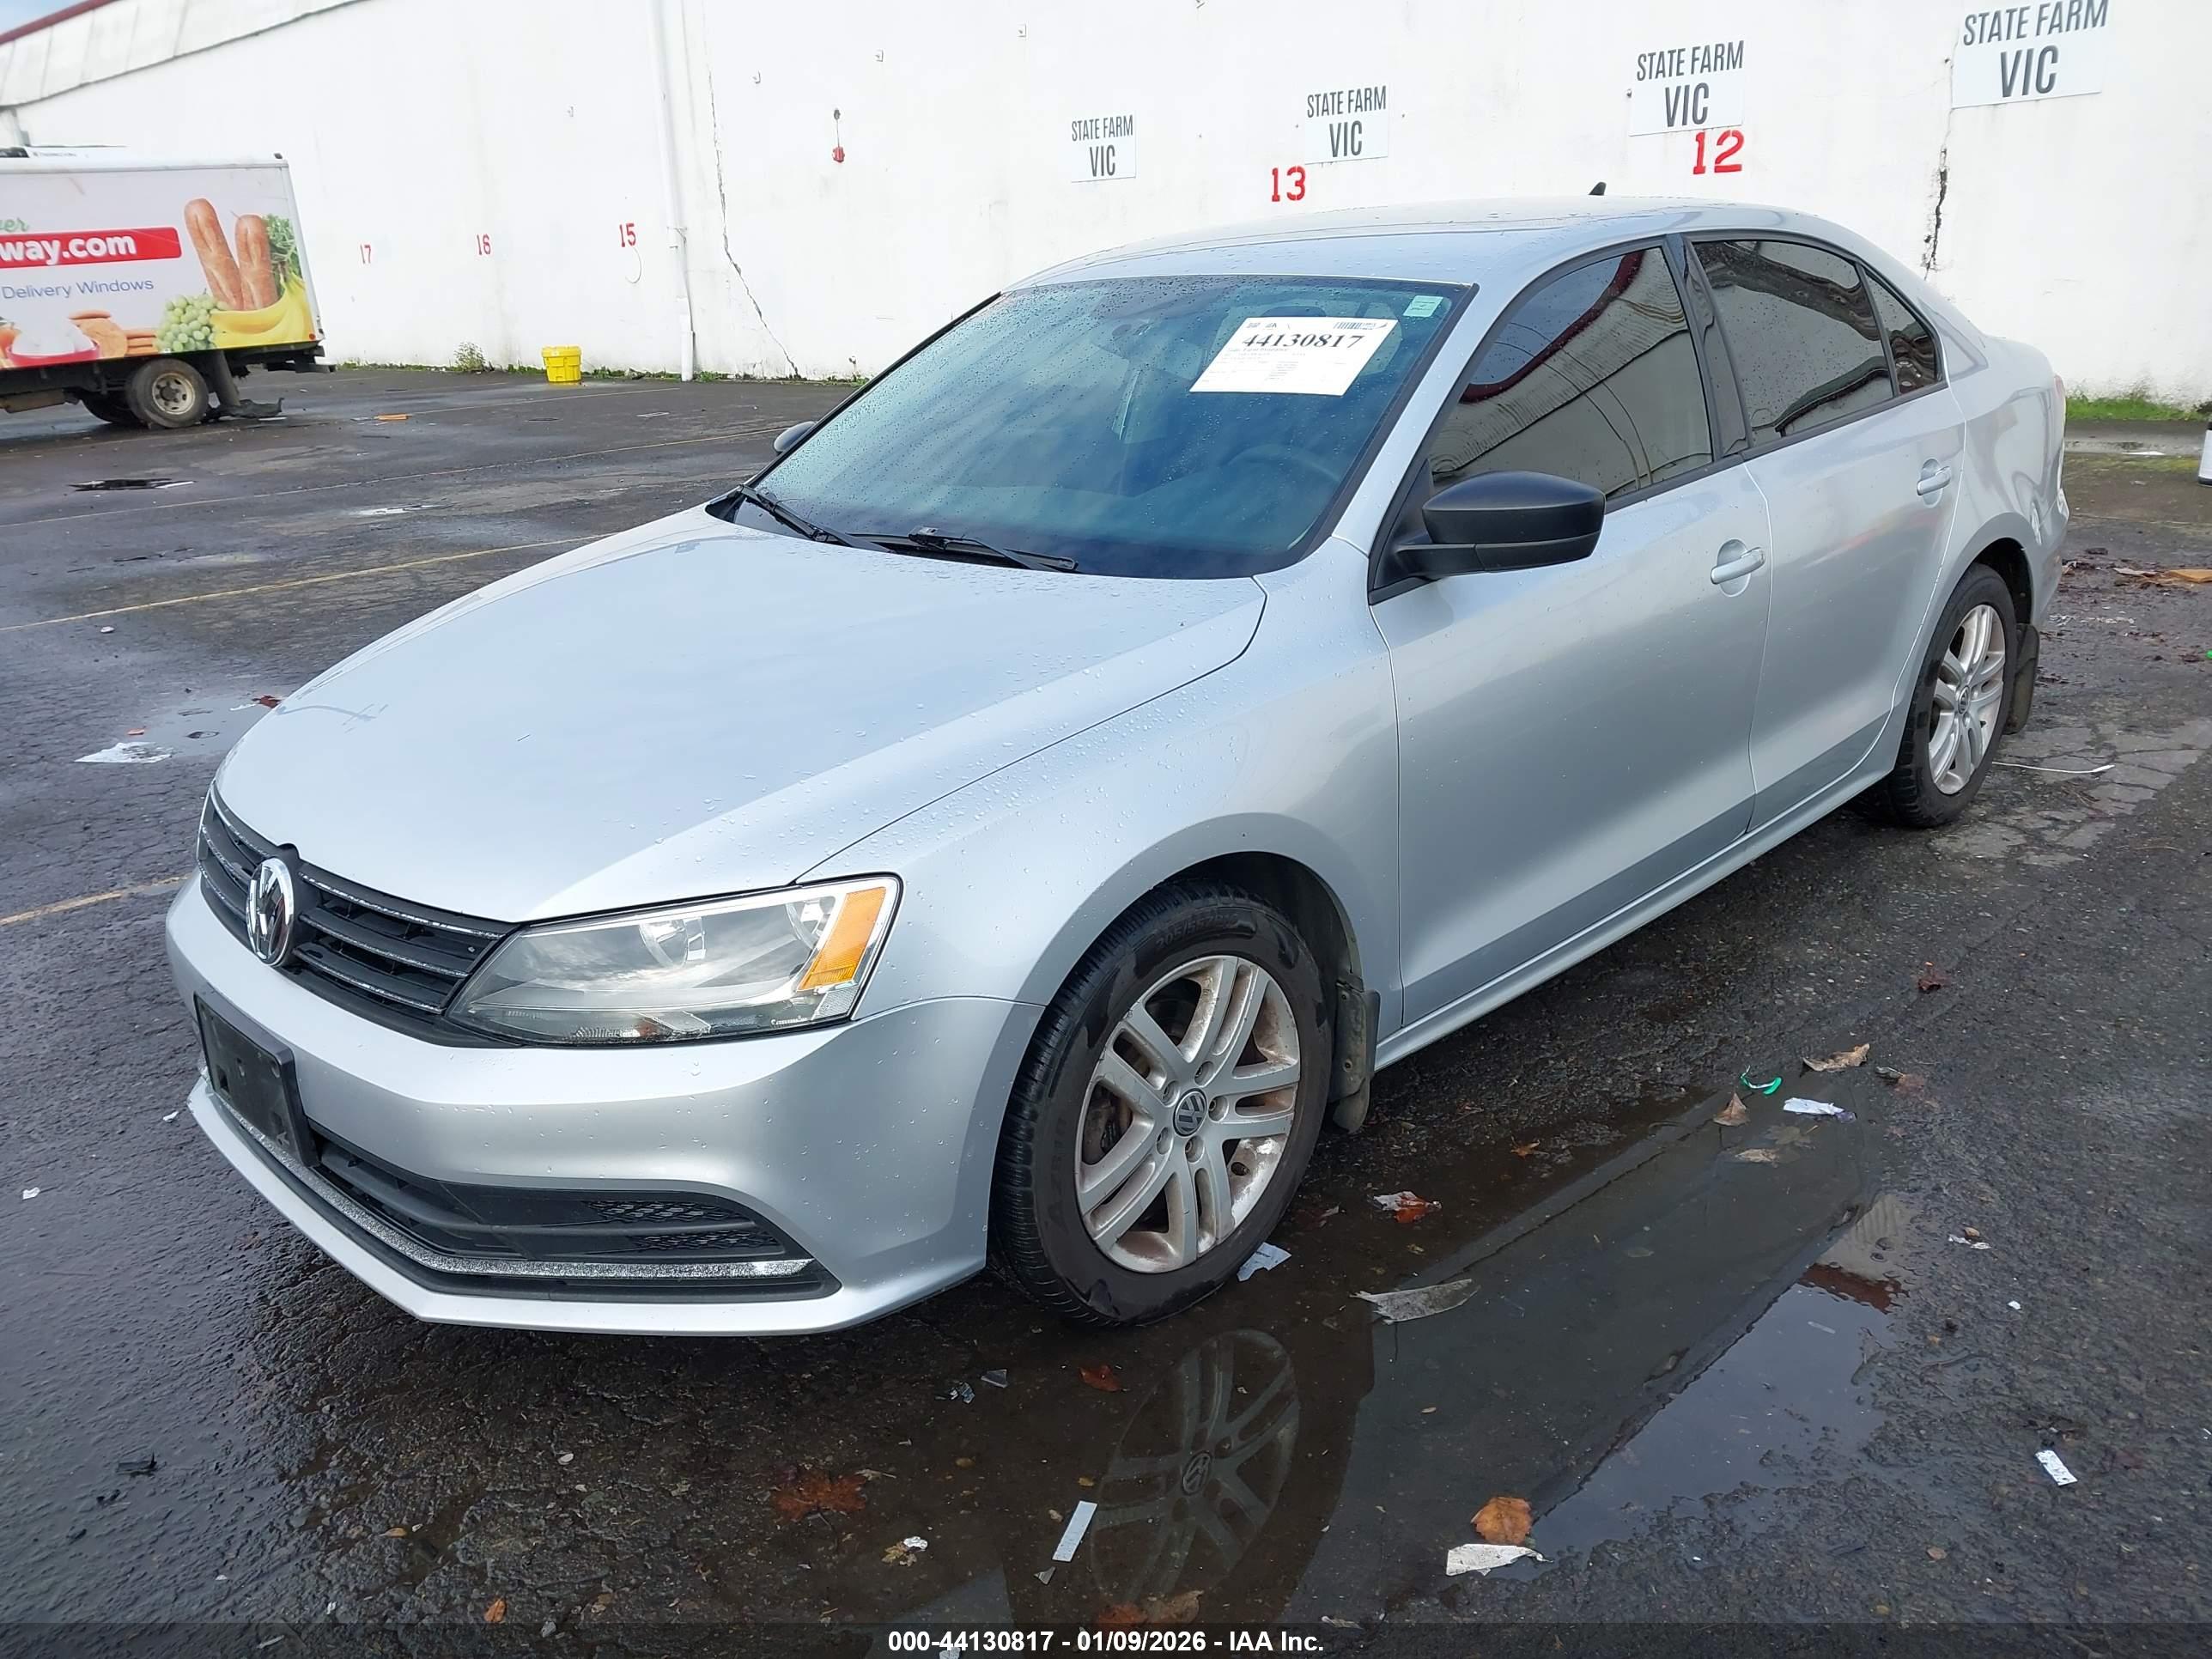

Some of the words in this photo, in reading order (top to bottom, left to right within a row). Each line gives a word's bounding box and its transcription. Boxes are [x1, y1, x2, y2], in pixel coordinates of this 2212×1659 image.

[1963, 6, 2031, 46] STATE
[2035, 0, 2109, 37] FARM
[1637, 48, 1686, 82] STATE
[1691, 40, 1744, 75] FARM
[2001, 45, 2059, 98] VIC
[1306, 90, 1344, 118] STATE
[1347, 86, 1387, 113] FARM
[1665, 82, 1710, 127] VIC
[1071, 117, 1100, 142] STATE
[1103, 114, 1133, 138] FARM
[1328, 120, 1364, 158] VIC
[1089, 144, 1116, 178] VIC
[1692, 130, 1745, 175] 12
[1271, 166, 1306, 203] 13
[0, 235, 137, 265] way.com
[477, 233, 491, 255] 16
[619, 222, 637, 247] 15
[359, 244, 371, 264] 17
[2, 285, 71, 299] Delivery
[76, 279, 155, 294] Windows
[1242, 332, 1365, 349] 44130817
